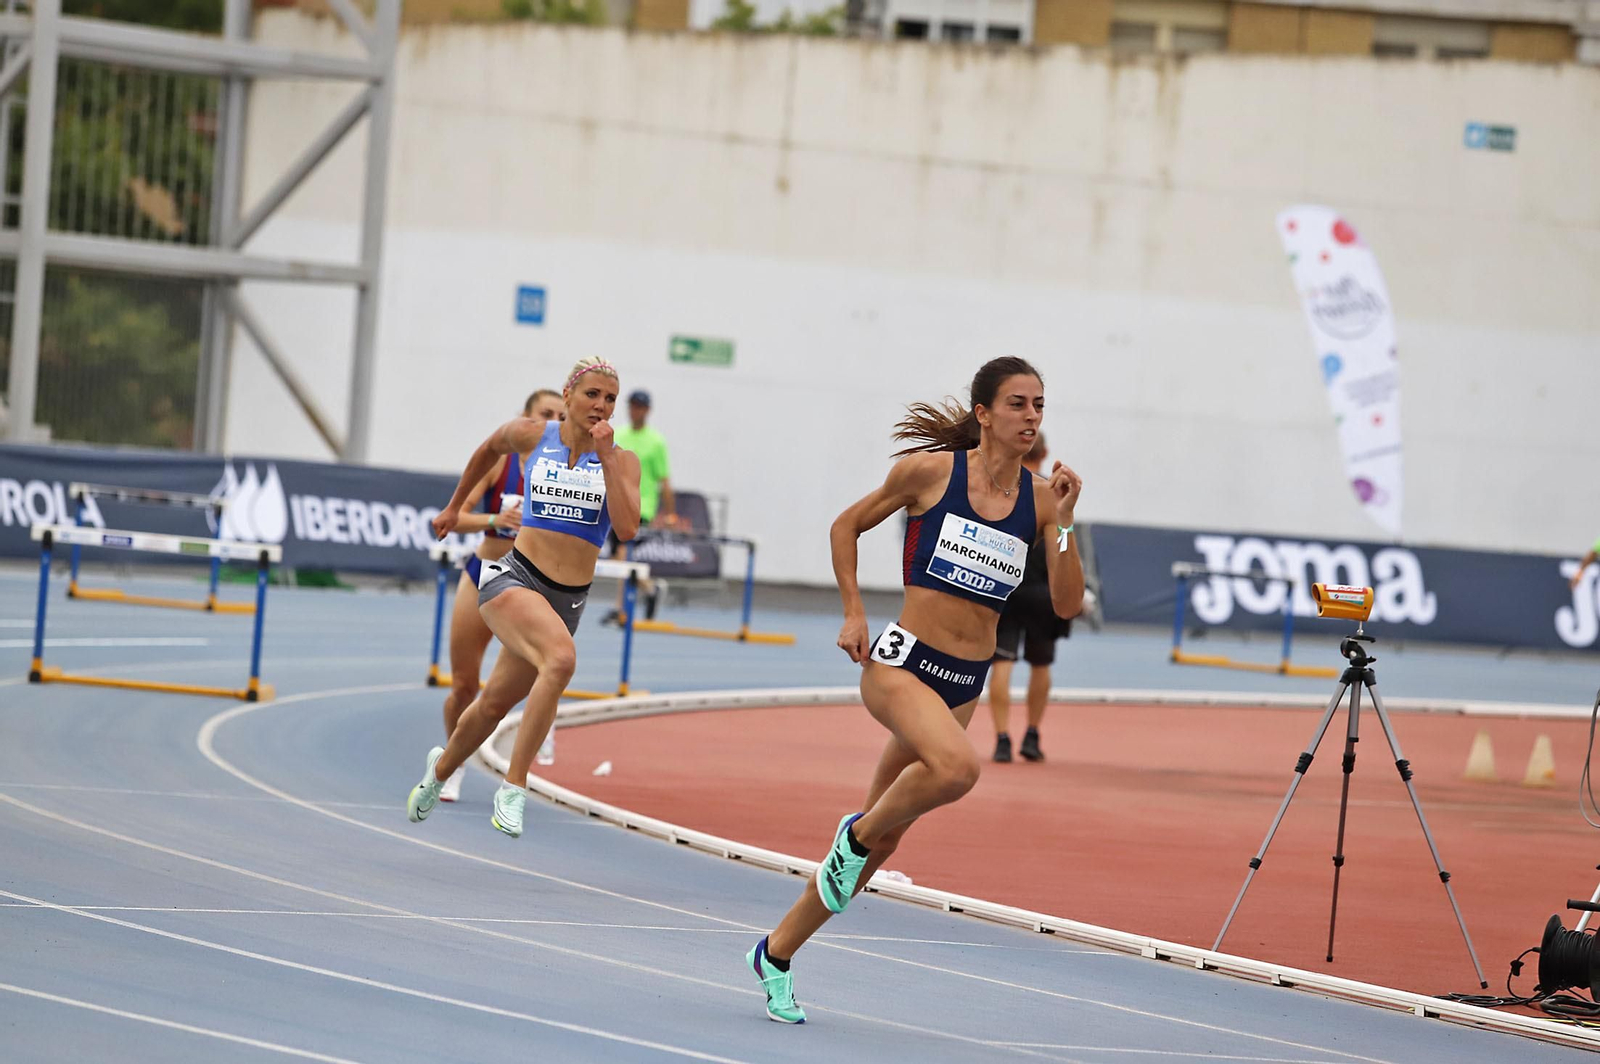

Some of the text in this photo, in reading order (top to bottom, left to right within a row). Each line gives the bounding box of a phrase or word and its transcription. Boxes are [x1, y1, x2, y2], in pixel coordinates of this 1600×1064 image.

[531, 484, 602, 503] KLEEMEIER
[939, 539, 1022, 578] MARCHIANDO
[878, 630, 905, 659] 3
[919, 659, 976, 685] CARABINIERI
